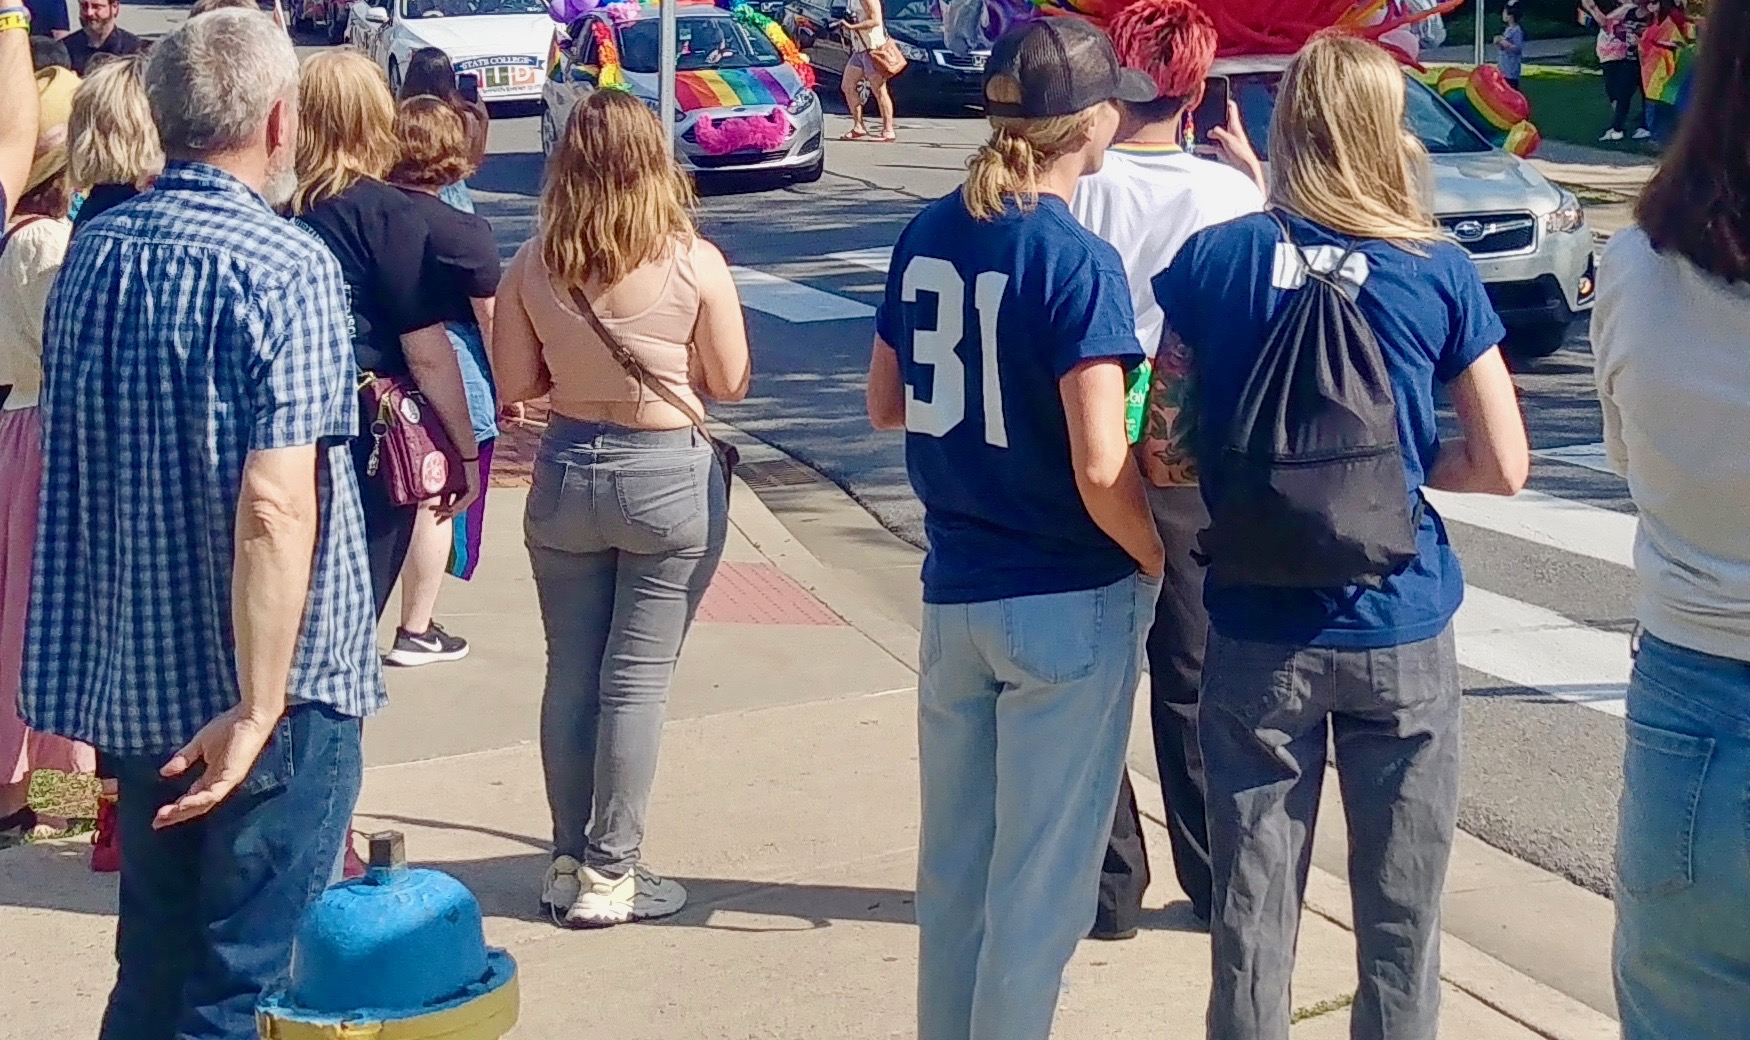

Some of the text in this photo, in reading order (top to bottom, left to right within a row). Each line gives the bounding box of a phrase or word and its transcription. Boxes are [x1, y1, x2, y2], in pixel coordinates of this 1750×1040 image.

[462, 56, 530, 70] STATE COLLEGE
[901, 255, 1010, 449] 31
